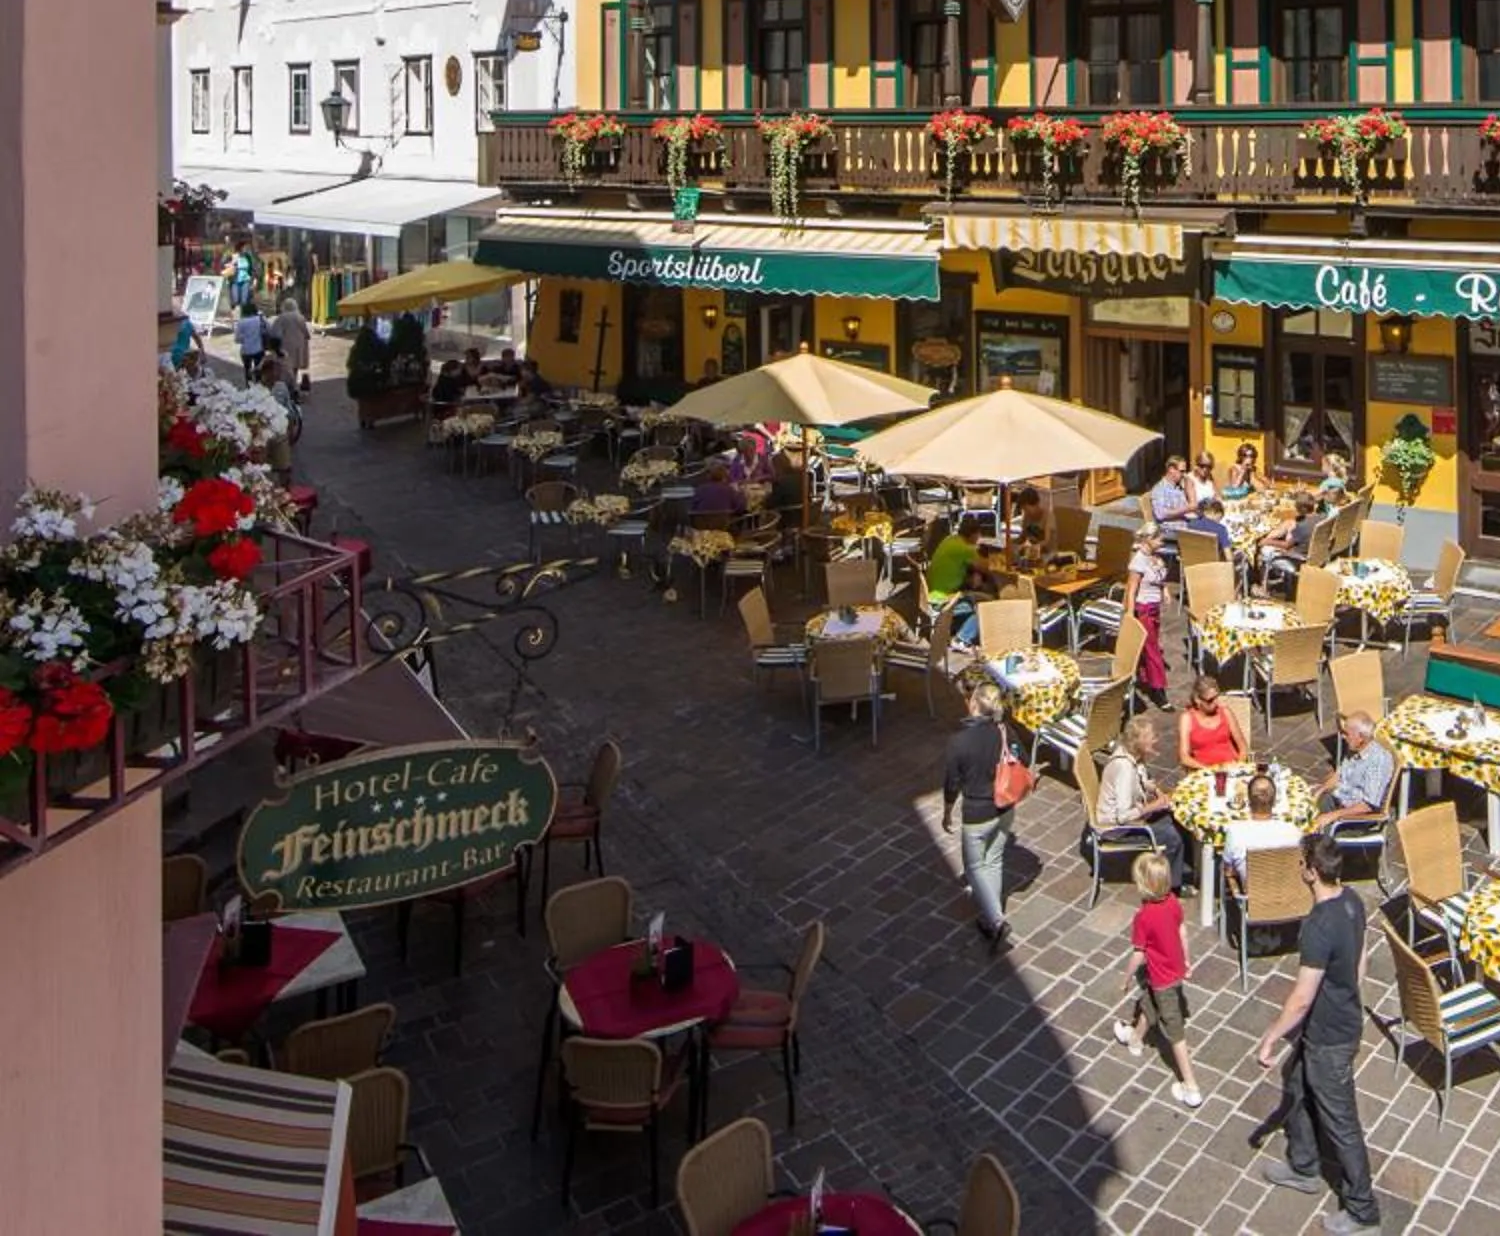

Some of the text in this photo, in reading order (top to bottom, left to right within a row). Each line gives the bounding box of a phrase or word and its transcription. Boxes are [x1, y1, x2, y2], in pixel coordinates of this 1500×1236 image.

[608, 249, 765, 285] Sportstüberl
[1315, 265, 1387, 308] Café
[261, 788, 530, 883] Feinschmeck
[295, 842, 507, 900] Restaurant-Bar
